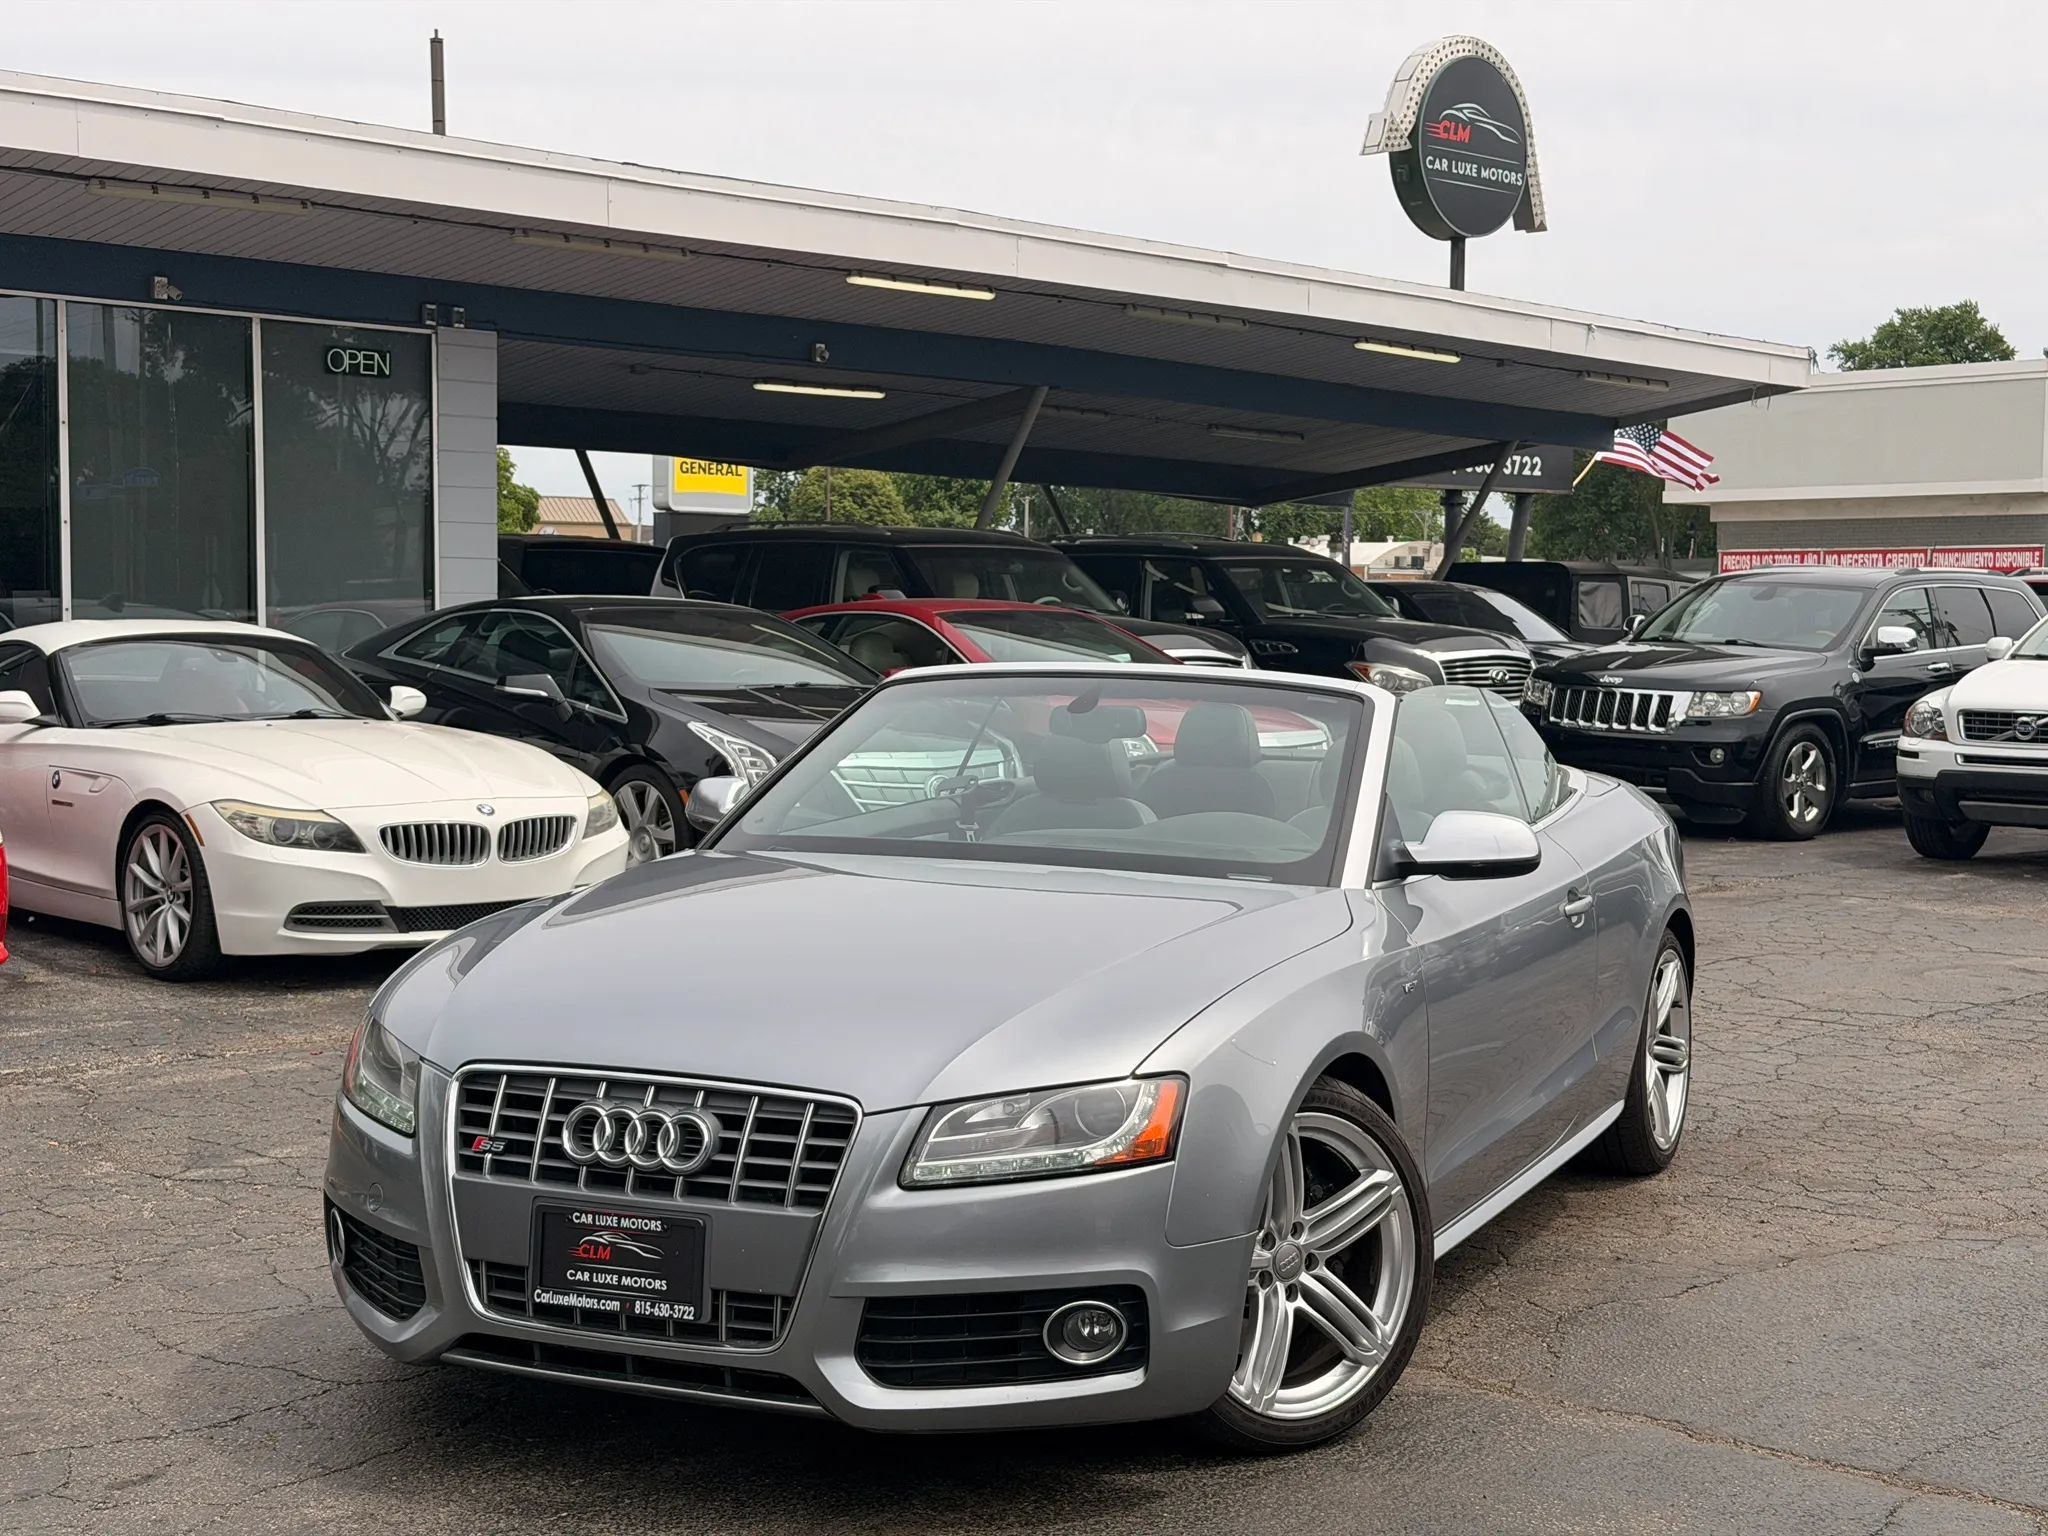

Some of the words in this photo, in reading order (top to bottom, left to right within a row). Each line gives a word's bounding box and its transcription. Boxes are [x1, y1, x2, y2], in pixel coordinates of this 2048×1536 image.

[1439, 120, 1473, 143] CLM
[1425, 155, 1449, 172] CAR
[1452, 160, 1478, 178] LUXE
[1480, 167, 1523, 186] MOTORS
[327, 348, 390, 376] OPEN
[680, 461, 742, 477] GENERAL
[1722, 554, 1751, 570] PRECIOS
[1825, 553, 1839, 566] NO
[1840, 553, 1883, 568] NECESITA
[1885, 552, 1925, 568] CREDITO
[1932, 551, 1994, 568] FINANCIAMIENTO
[1995, 550, 2040, 568] DISPONIBLE
[1600, 674, 1623, 685] Jeep
[572, 1211, 593, 1225] CAR
[595, 1214, 618, 1227] LUXE
[620, 1216, 662, 1232] MOTORS
[578, 1243, 612, 1261] CLM
[567, 1269, 590, 1282] CAR
[593, 1272, 619, 1286] LUXE
[620, 1276, 668, 1291] MOTORS
[534, 1289, 620, 1312] CarLuxeMotors.com
[634, 1302, 695, 1320] 815-630-3722
